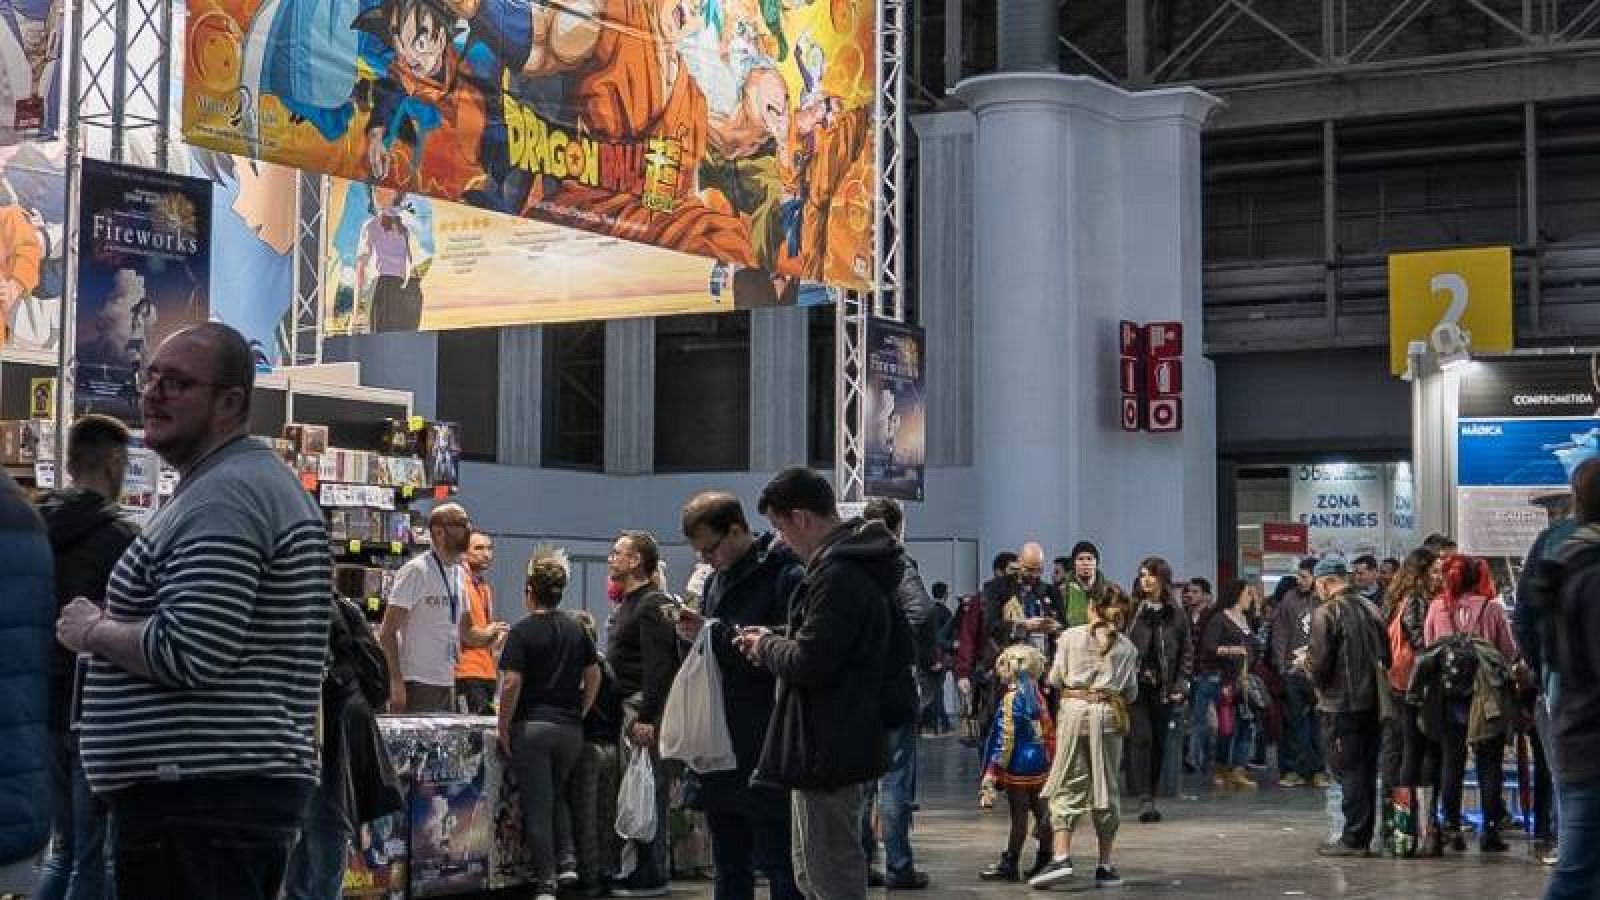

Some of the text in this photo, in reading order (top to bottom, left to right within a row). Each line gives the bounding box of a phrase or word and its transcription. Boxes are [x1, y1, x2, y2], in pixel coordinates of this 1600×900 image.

[503, 76, 599, 187] DRAGON
[94, 214, 198, 255] Fireworks
[1317, 494, 1361, 509] ZONA
